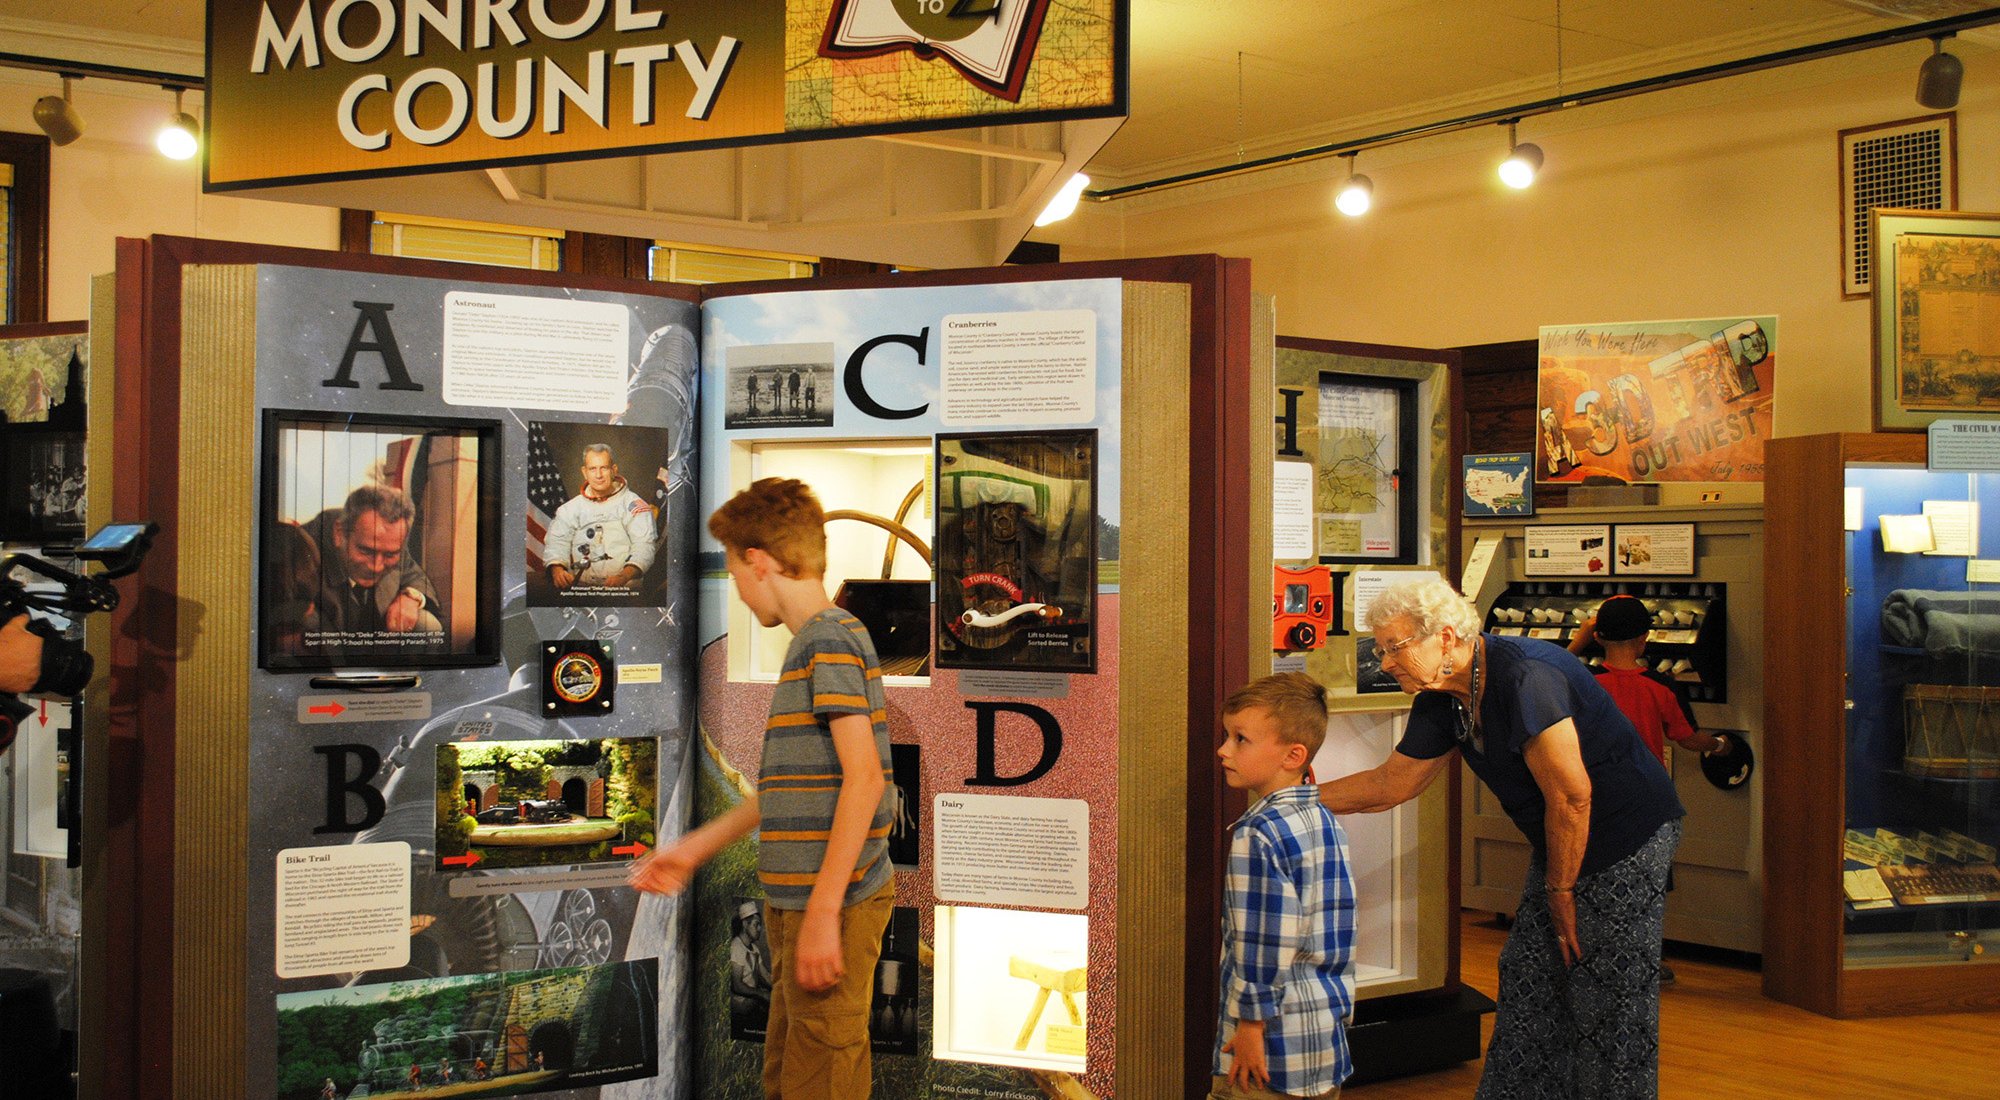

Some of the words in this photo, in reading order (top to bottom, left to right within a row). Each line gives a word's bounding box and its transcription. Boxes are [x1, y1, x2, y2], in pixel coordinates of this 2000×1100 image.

[918, 0, 944, 14] TO
[338, 36, 737, 150] COUNTY
[453, 298, 496, 308] Astronaut
[948, 320, 998, 329] Cranberries
[322, 301, 424, 391] A
[1544, 330, 1569, 352] Wish
[1575, 329, 1592, 347] You
[1598, 332, 1626, 350] Were
[1629, 332, 1658, 355] Here
[844, 326, 930, 420] C
[1647, 319, 1768, 420] TRIP
[1969, 424, 1989, 433] CIVIL
[1631, 434, 1682, 477] OUT
[1686, 406, 1758, 455] WEST
[1710, 460, 1732, 480] July
[969, 574, 991, 583] TURN
[992, 576, 1017, 594] CRANK
[458, 726, 490, 734] STATES
[964, 701, 1063, 787] D
[313, 744, 386, 834] B
[941, 800, 964, 810] Dairy
[286, 856, 306, 864] Bike
[310, 854, 330, 862] Trail
[932, 1083, 955, 1093] Photo
[956, 1086, 981, 1095] Credit:
[984, 1089, 1004, 1098] Lorry
[1005, 1090, 1036, 1100] Erickson
